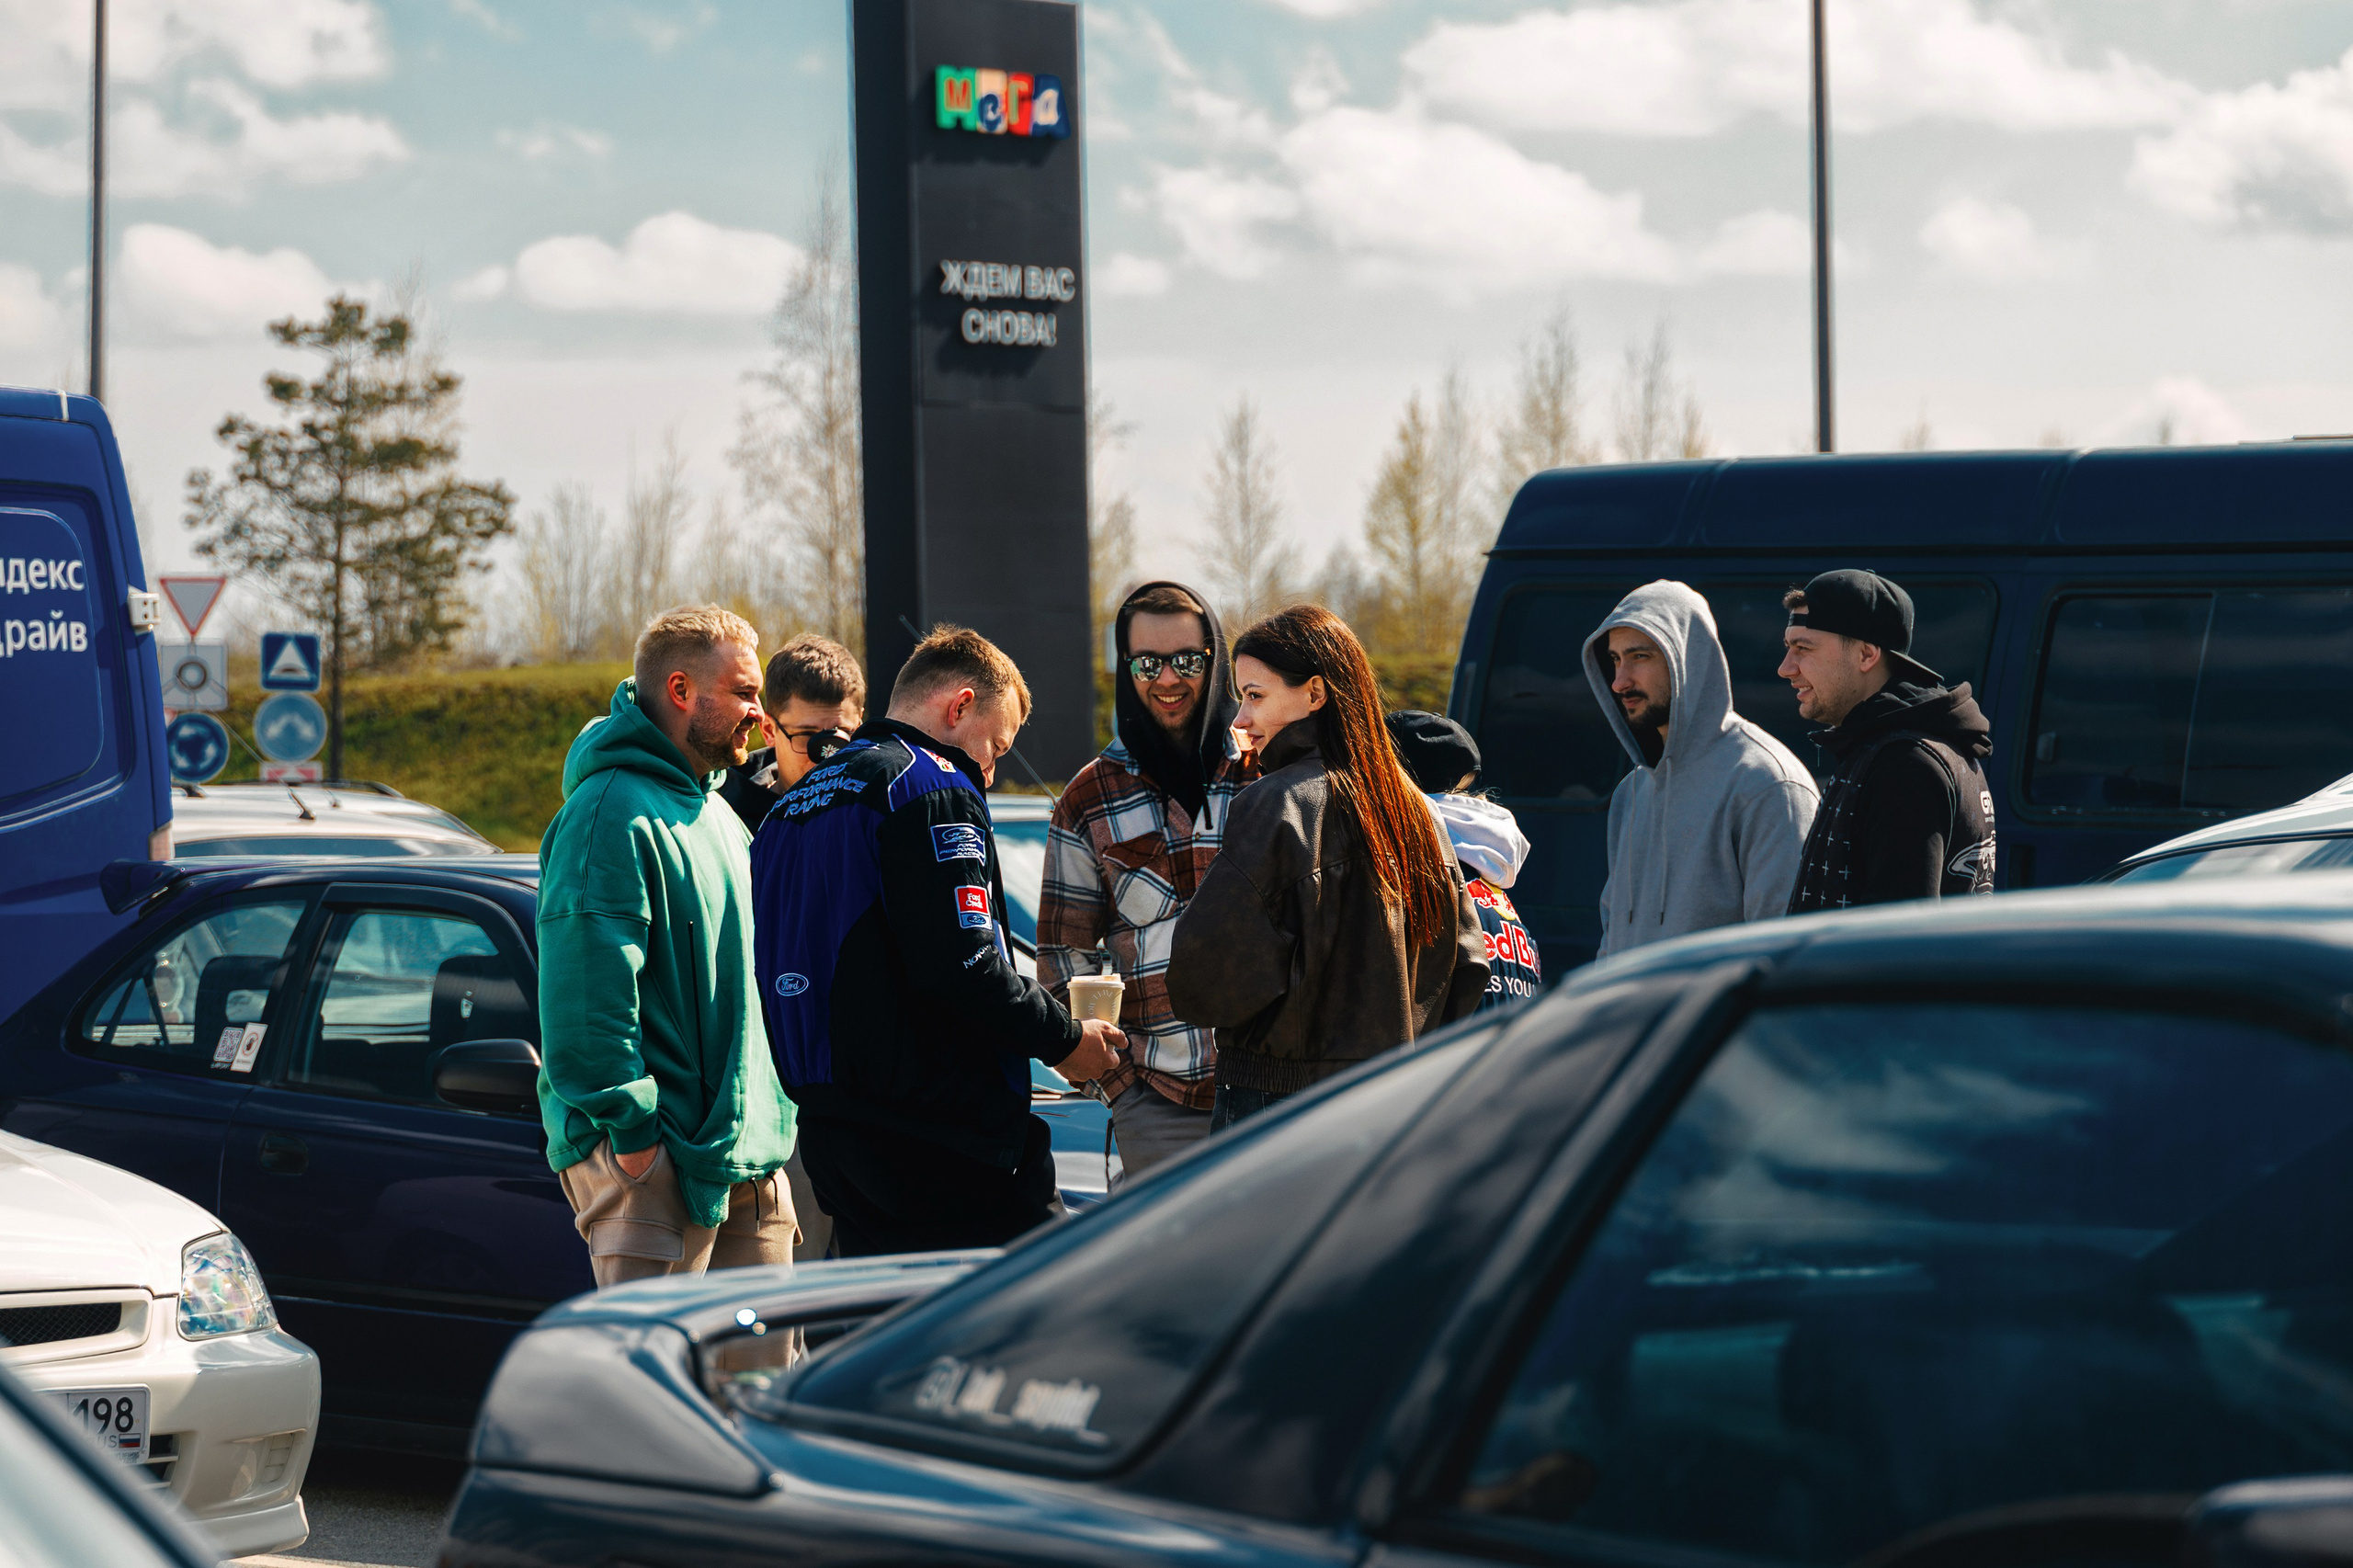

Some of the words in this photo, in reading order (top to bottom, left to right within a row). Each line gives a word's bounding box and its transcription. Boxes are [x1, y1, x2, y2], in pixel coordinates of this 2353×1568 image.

[939, 259, 1022, 302] ЖДЕМ
[1023, 265, 1075, 303] ВАС
[961, 307, 1057, 347] СНОВА!
[0, 608, 88, 658] райв
[805, 762, 848, 784] FORD
[1483, 920, 1517, 964] ed
[1504, 976, 1531, 998] YOU
[73, 1396, 134, 1435] 198
